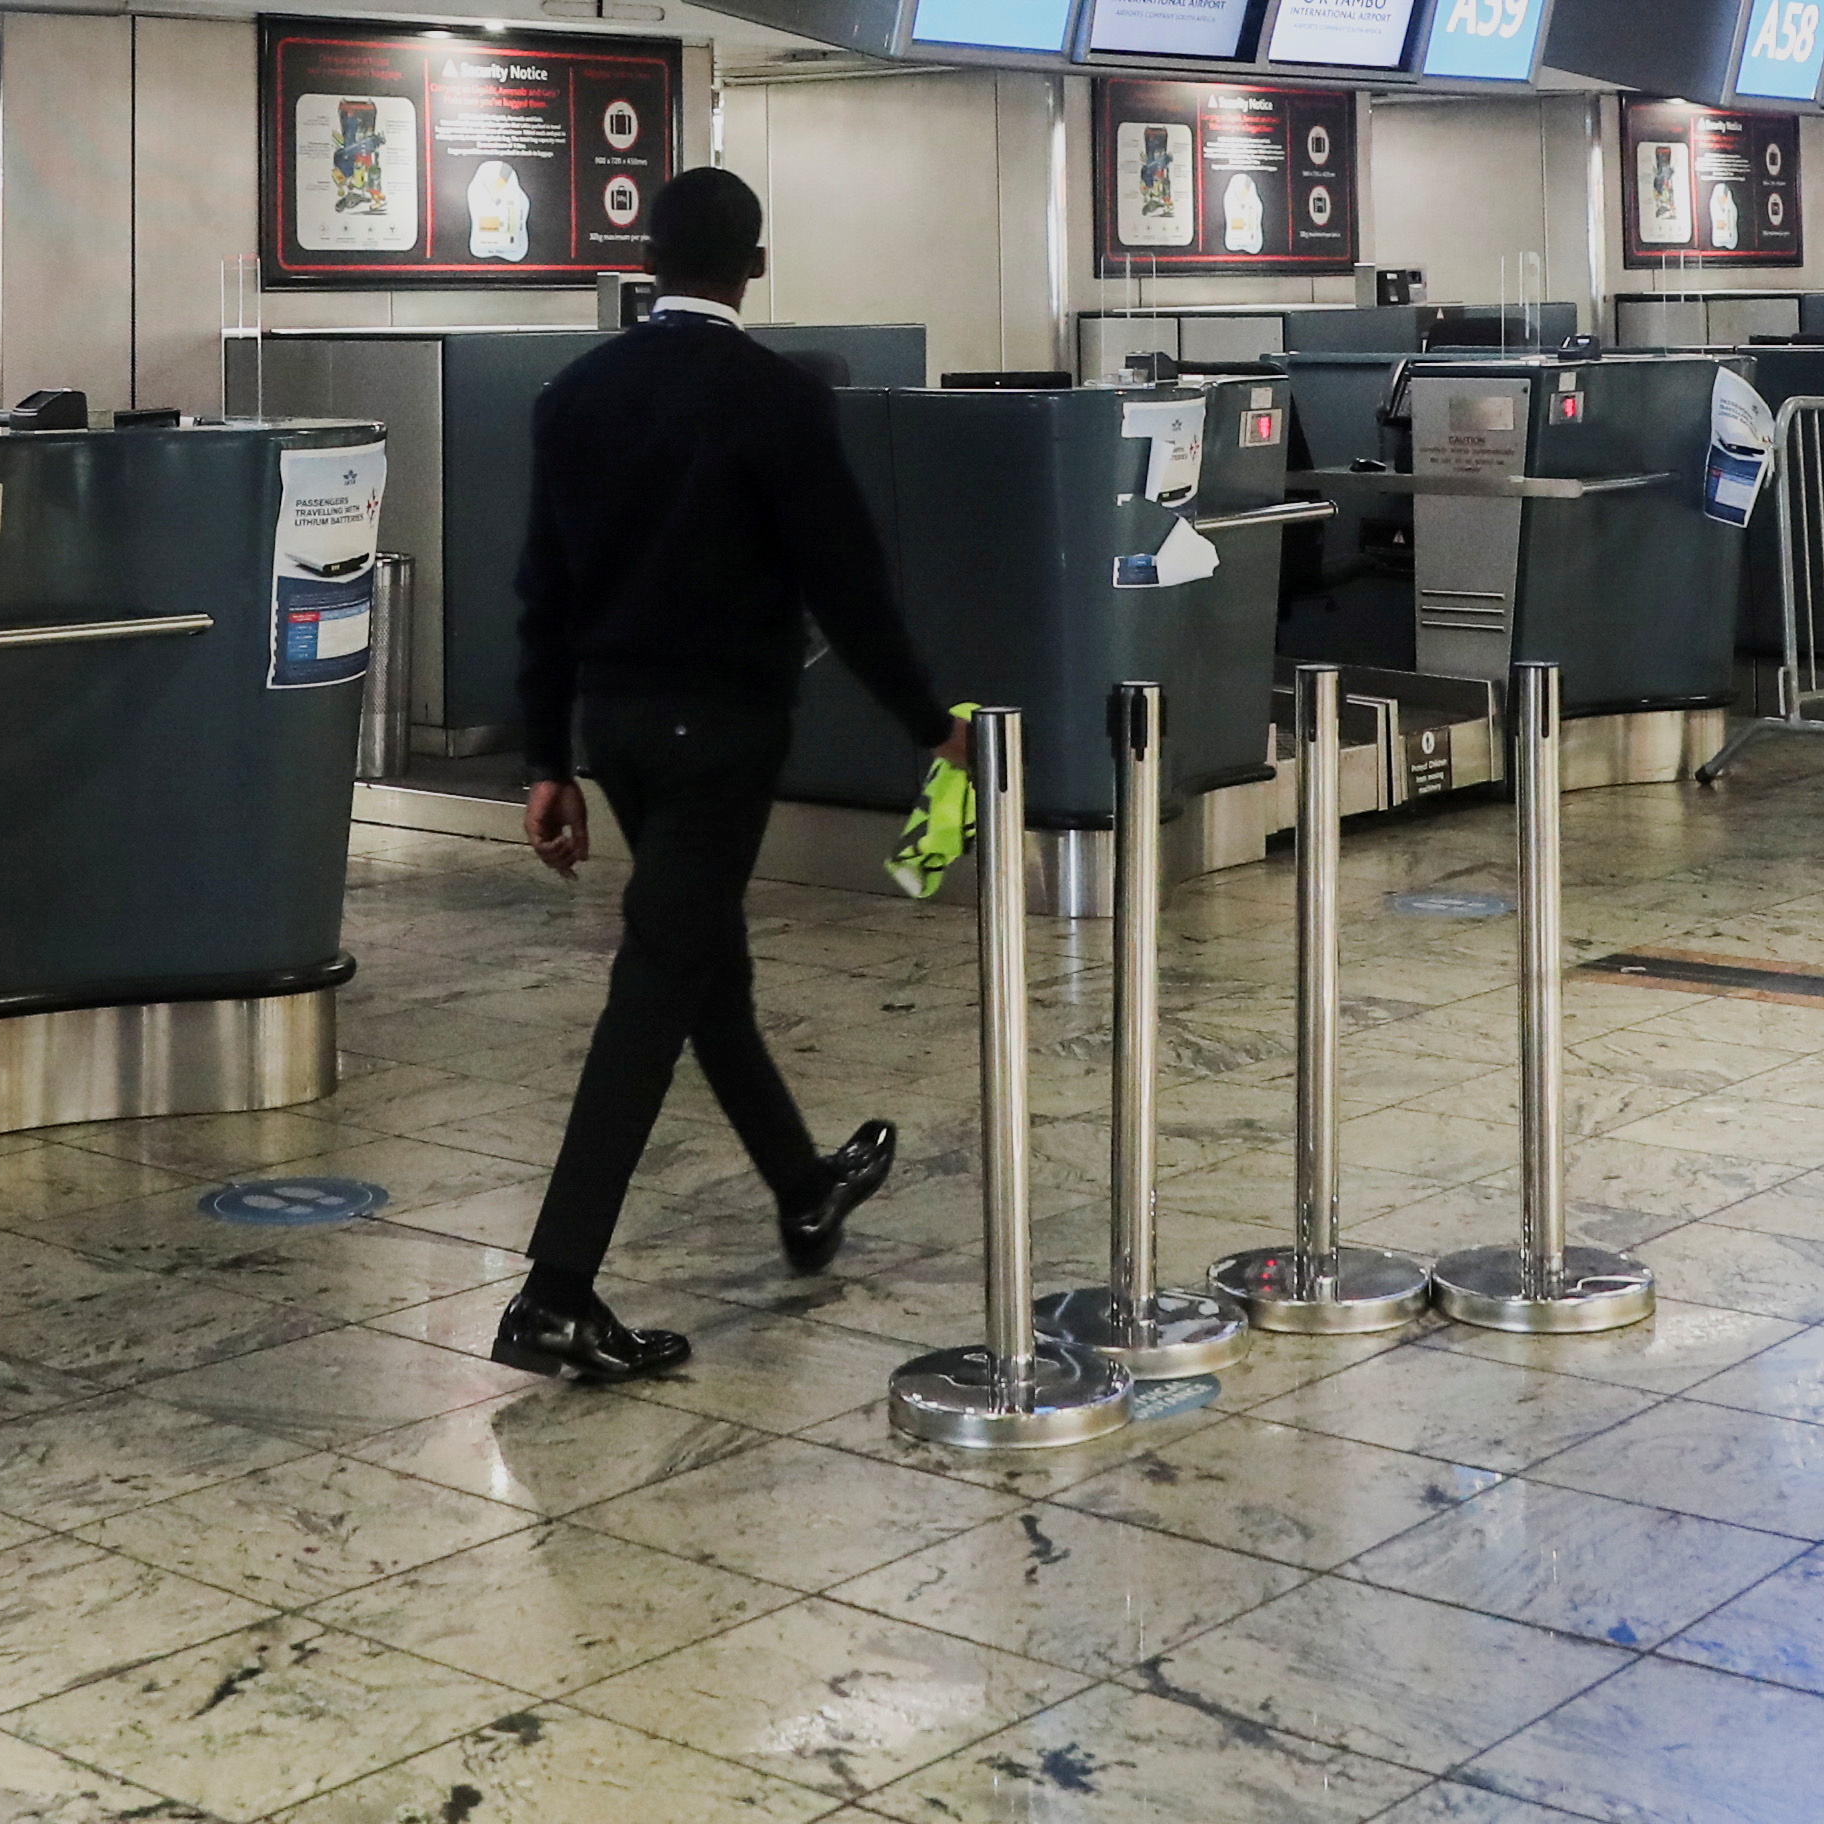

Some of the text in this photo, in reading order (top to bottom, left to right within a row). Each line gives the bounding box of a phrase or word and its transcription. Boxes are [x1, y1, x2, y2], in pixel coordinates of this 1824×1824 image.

[1289, 6, 1392, 23] INTERNATIONAL AIRPORT
[1751, 0, 1820, 63] A58
[460, 61, 549, 82] Security Notice
[1248, 97, 1274, 111] Notice
[1448, 436, 1486, 446] CAUTION
[295, 495, 350, 508] PASSENGERS
[294, 504, 361, 518] TRAVELLING WITH
[294, 512, 365, 527] LITHIUM BATTERIES
